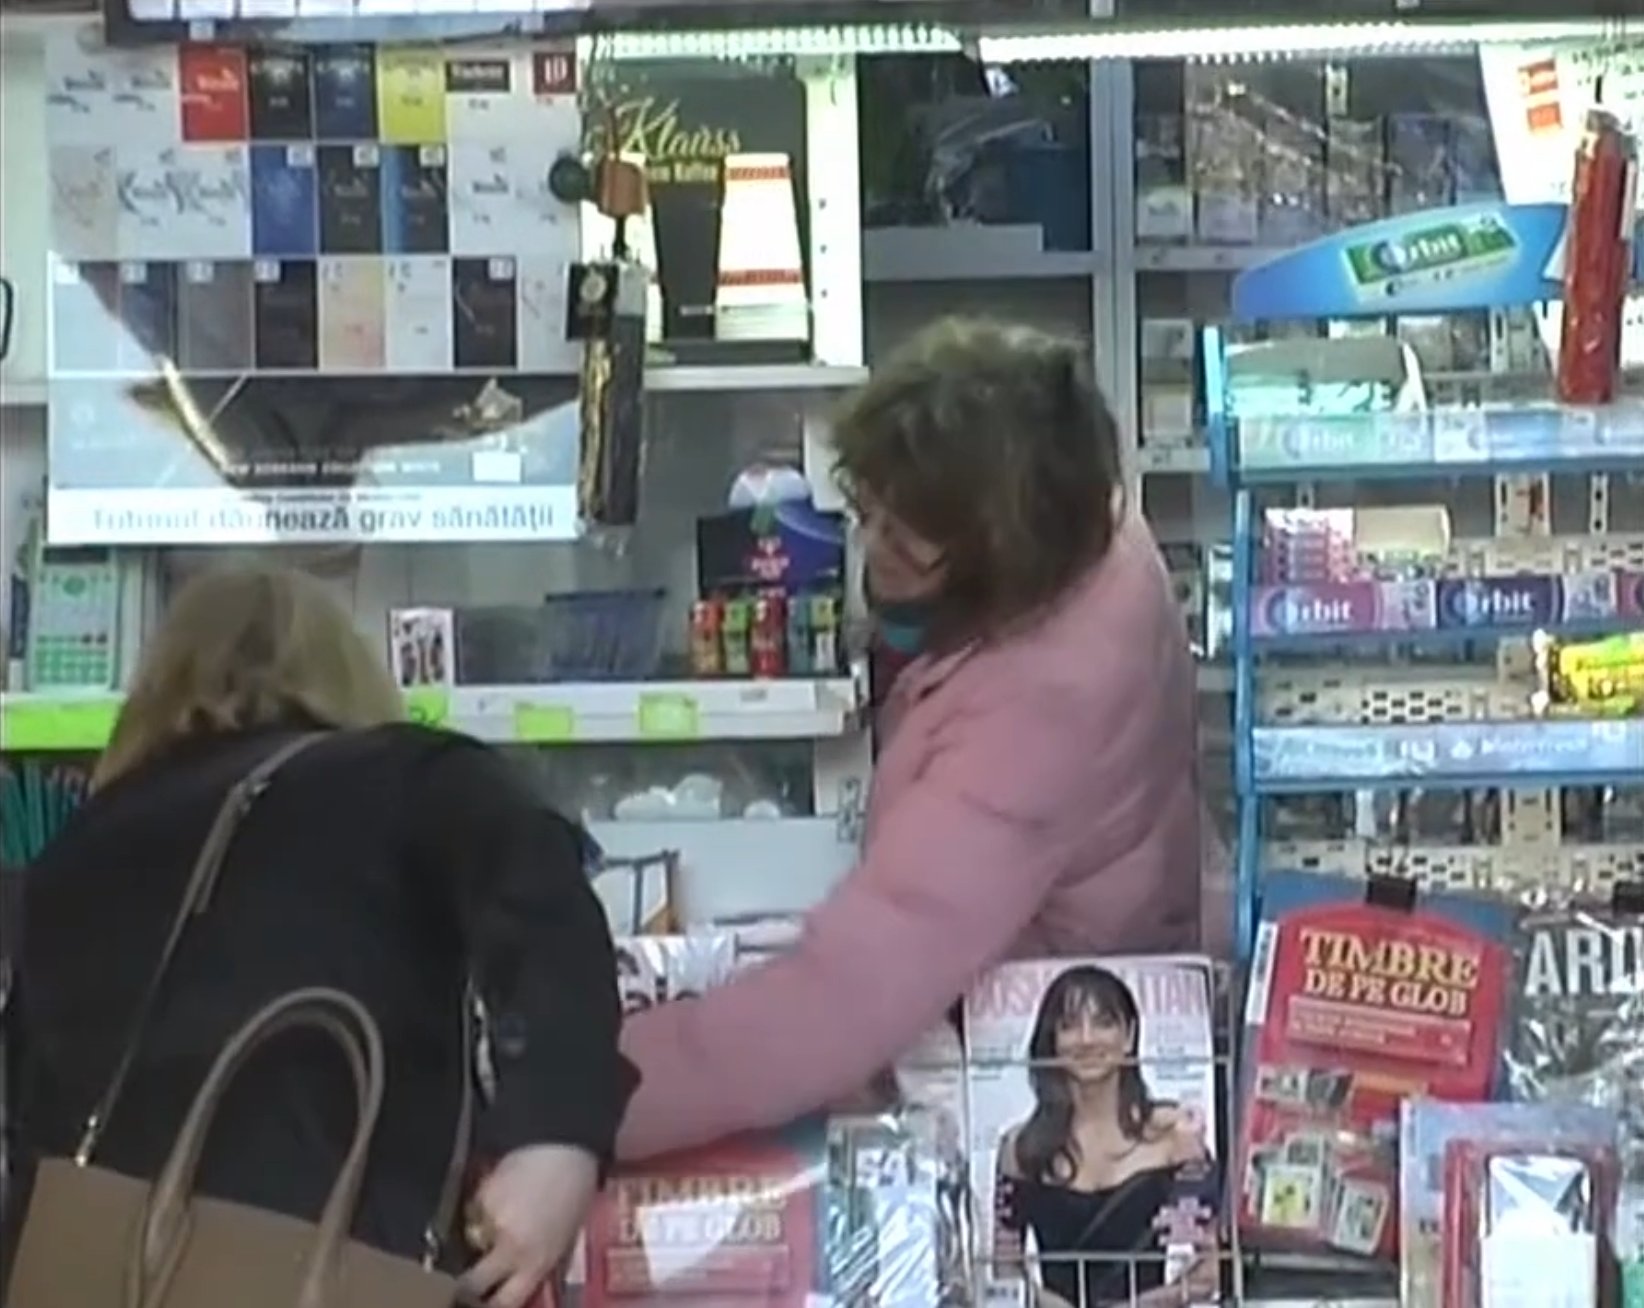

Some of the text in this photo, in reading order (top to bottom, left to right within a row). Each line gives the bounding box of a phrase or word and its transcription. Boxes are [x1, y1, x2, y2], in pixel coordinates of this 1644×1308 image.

[1371, 232, 1462, 275] Orbit
[359, 509, 422, 533] grav
[1266, 588, 1351, 633] Orbit
[1446, 583, 1532, 625] Orbit
[1300, 926, 1480, 989] TIMBRE
[1305, 968, 1468, 1016] DE PE GLOB
[605, 1176, 787, 1209] TIMBRE
[704, 1211, 782, 1242] GLOB
